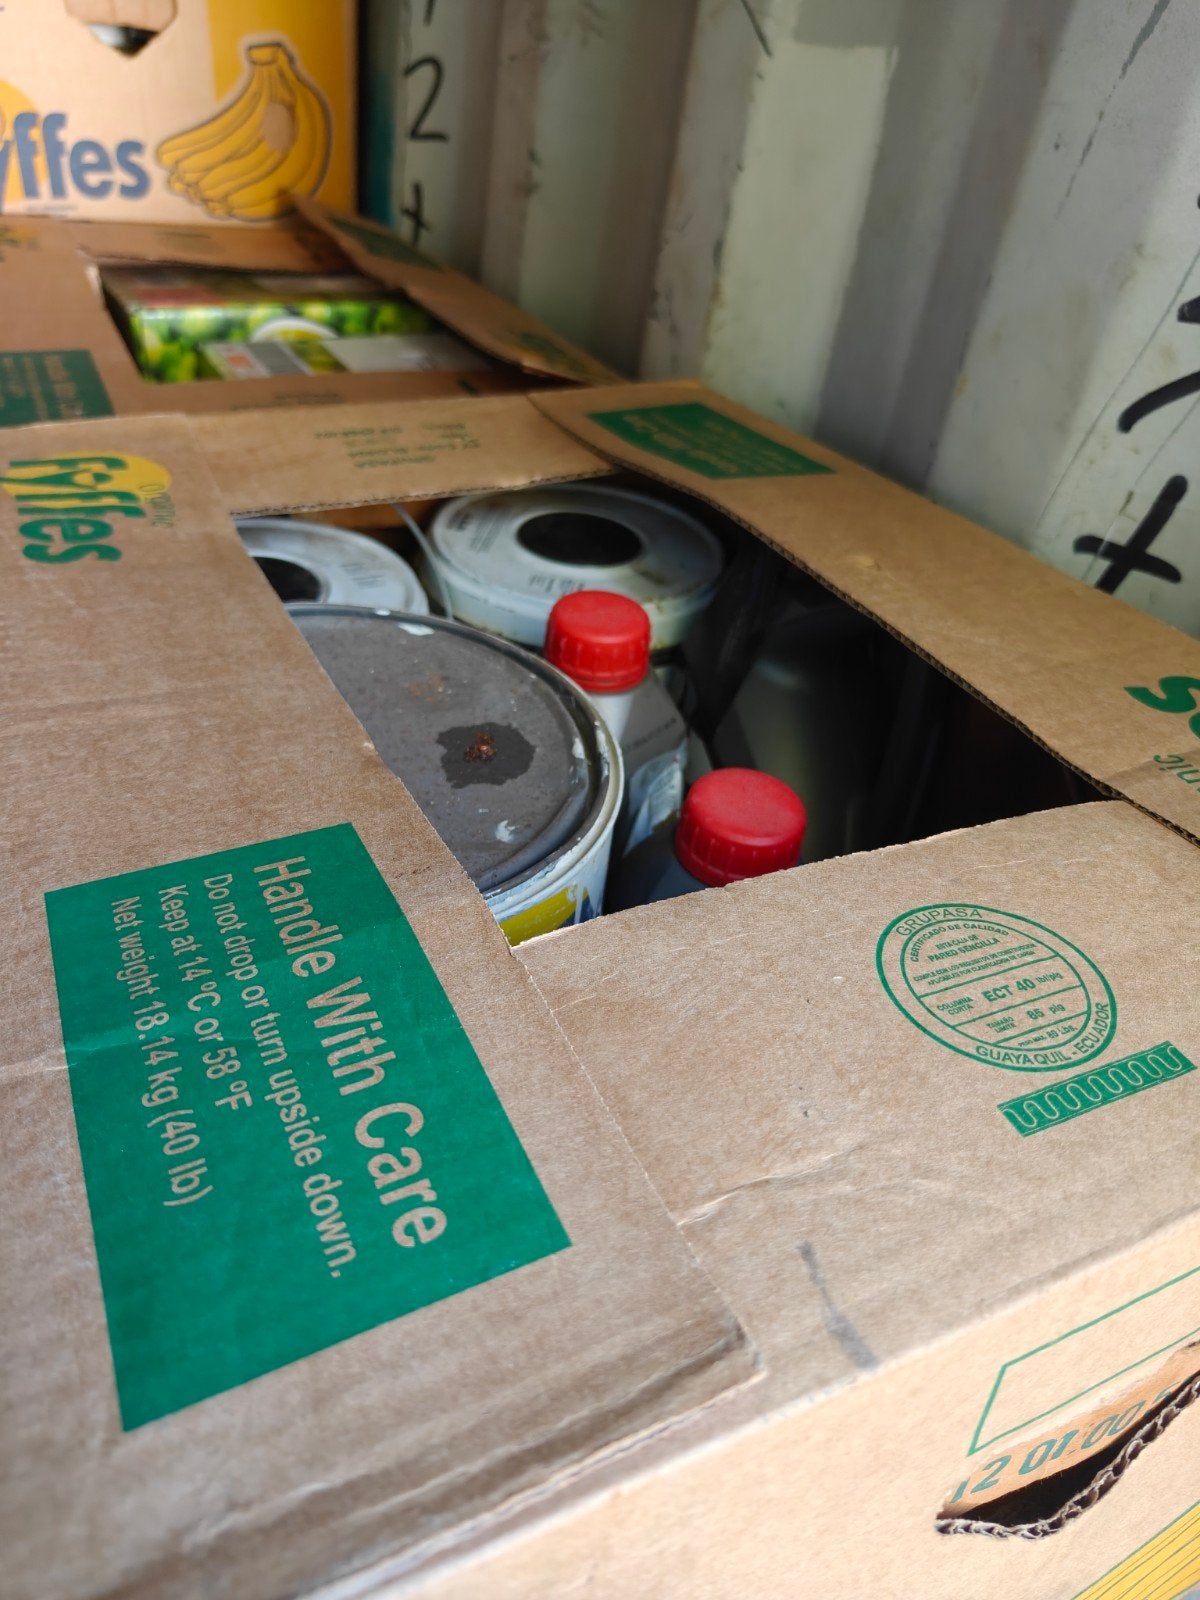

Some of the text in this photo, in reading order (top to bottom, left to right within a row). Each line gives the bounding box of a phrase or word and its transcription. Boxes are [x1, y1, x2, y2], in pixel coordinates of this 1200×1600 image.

[404, 56, 449, 142] 2
[0, 457, 146, 564] fyffes
[158, 884, 190, 932] Keep
[895, 908, 983, 936] GRUPASA
[171, 935, 202, 956] at
[910, 926, 947, 962] CERTIFICADO
[963, 923, 1010, 936] CALIDAD
[928, 937, 1001, 962] PARED SENCILLA
[178, 956, 213, 981] 14
[937, 996, 974, 1011] COLUMNA
[981, 985, 1013, 1002] ECT
[1016, 978, 1036, 992] 40
[948, 1004, 974, 1015] CORTA
[194, 1018, 224, 1042] or
[1025, 1008, 1045, 1020] 85
[976, 1045, 1072, 1065] GUAYAQUIL
[1074, 1002, 1109, 1054] ECUADOR
[111, 896, 213, 1206] Net weight 18.14 kg (40 lb)
[202, 1047, 241, 1079] 58
[253, 856, 447, 1248] Handle With Care
[203, 873, 357, 1278] Do not drop or turn upside down.
